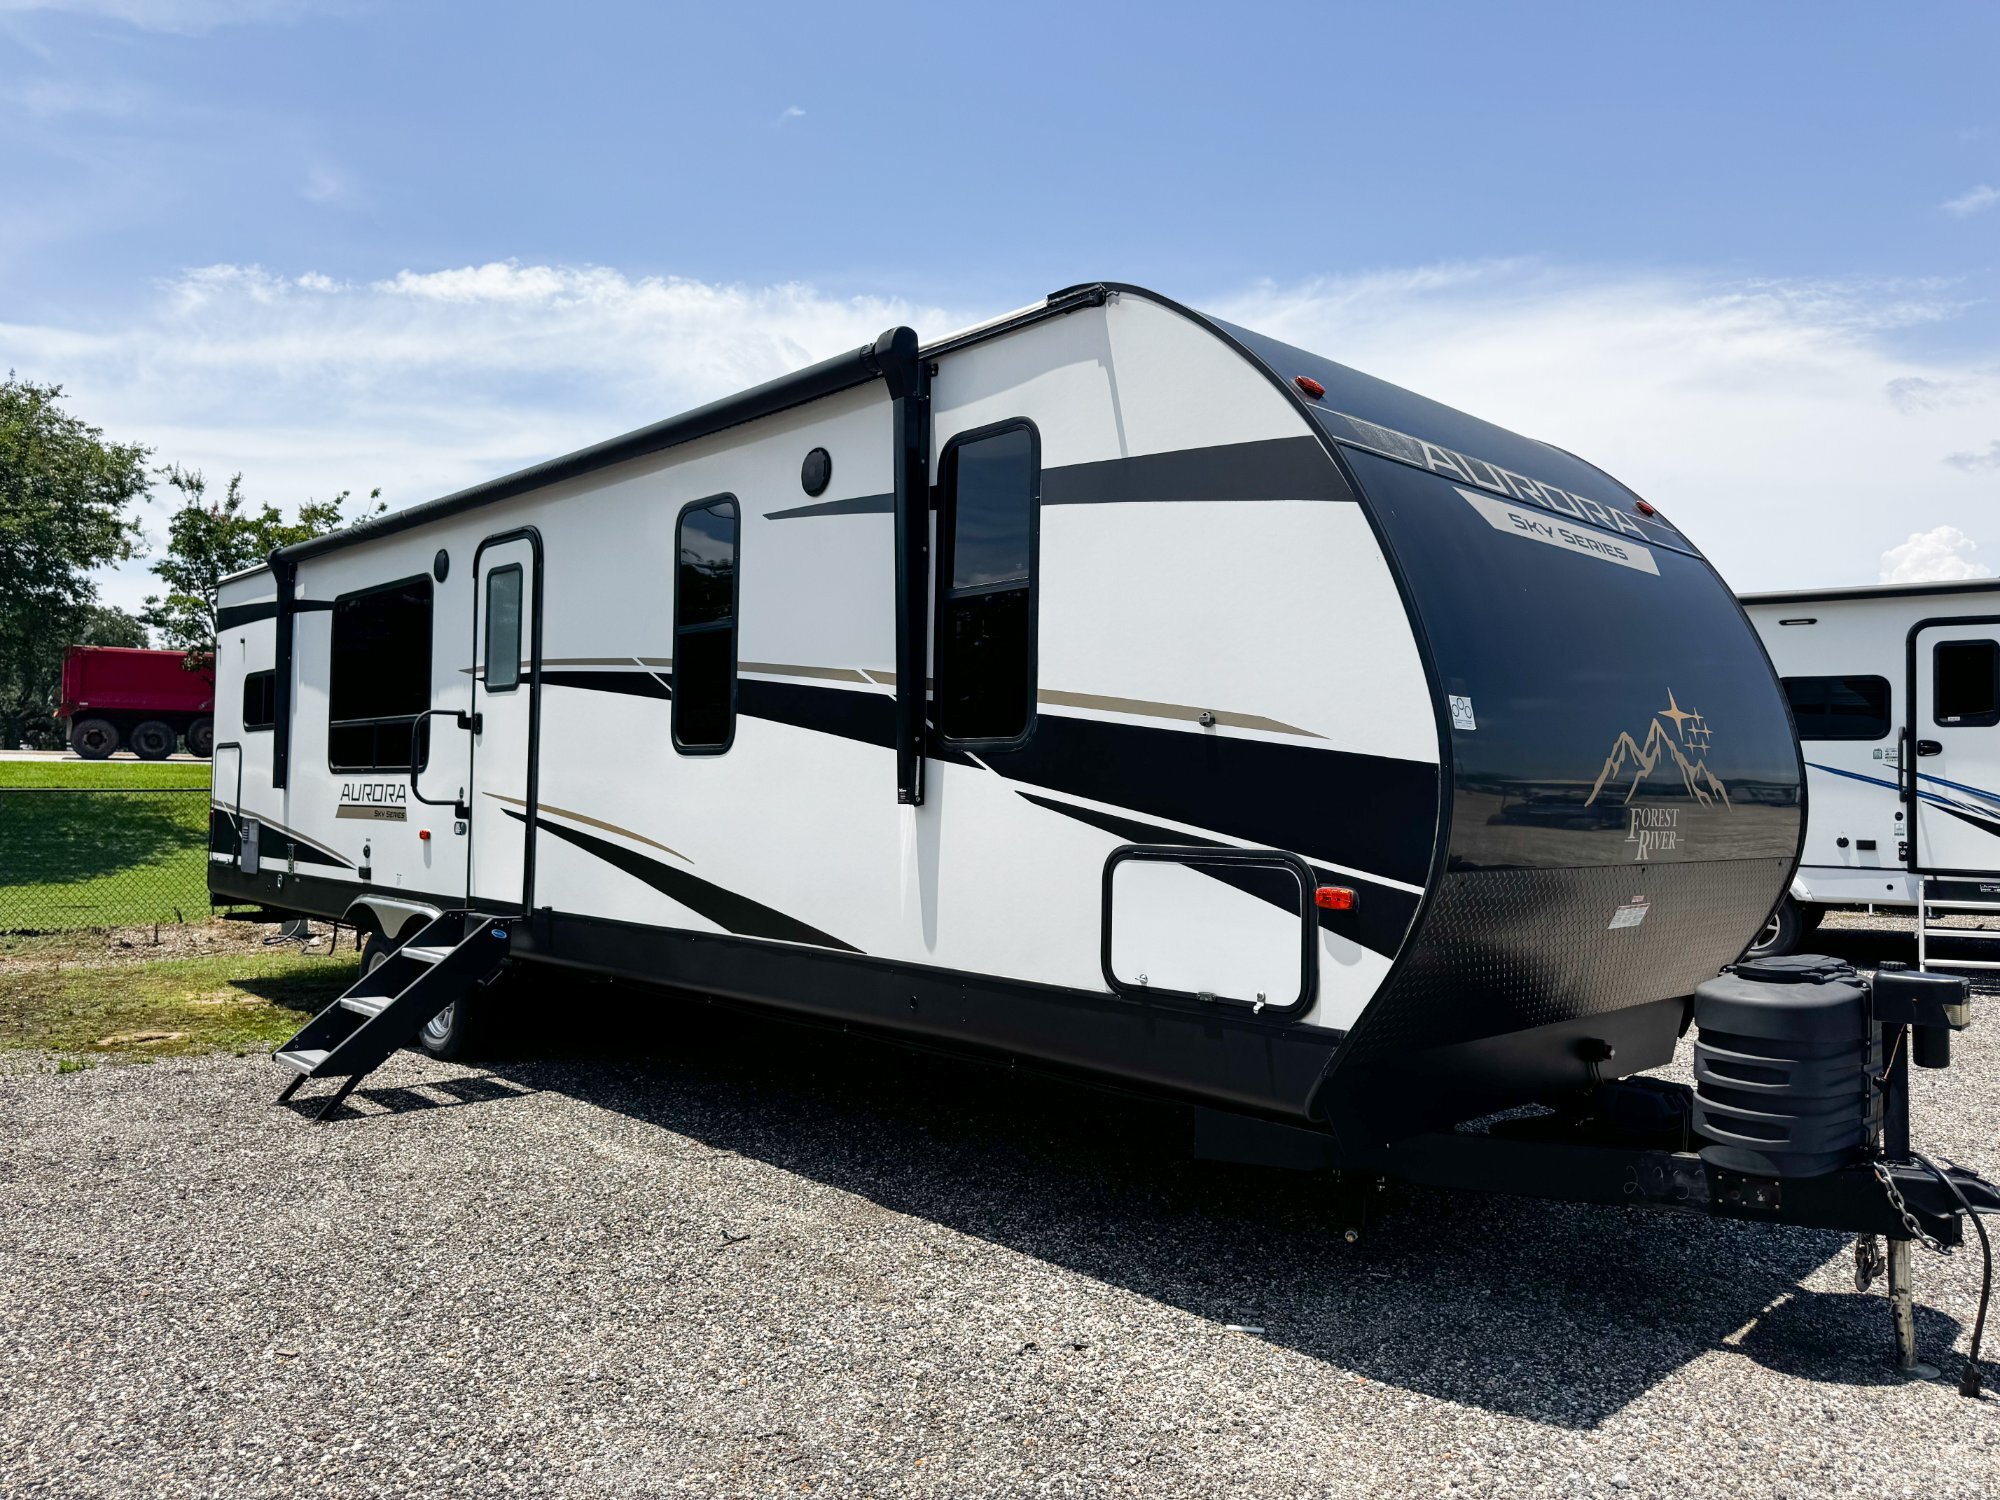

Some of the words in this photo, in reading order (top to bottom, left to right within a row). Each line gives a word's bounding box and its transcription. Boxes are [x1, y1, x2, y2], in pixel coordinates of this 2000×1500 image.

[1420, 442, 1651, 541] AURORA
[1508, 512, 1554, 539] SKY
[1560, 528, 1629, 561] SERIES
[340, 783, 407, 803] AURORA
[374, 809, 386, 818] SKY
[1628, 808, 1680, 839] FOREST
[1634, 830, 1676, 861] RIVER
